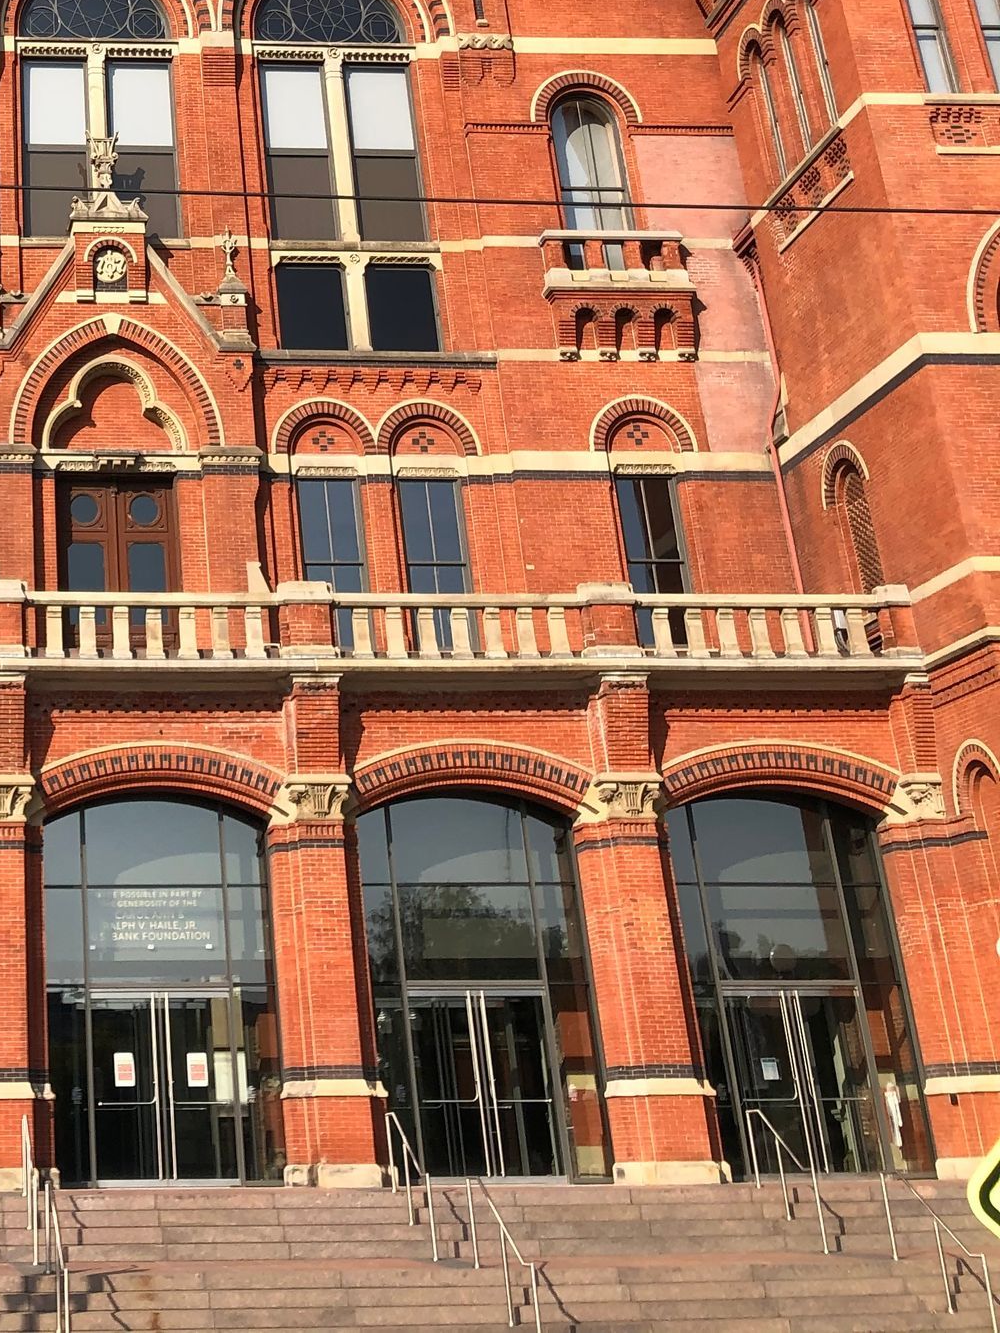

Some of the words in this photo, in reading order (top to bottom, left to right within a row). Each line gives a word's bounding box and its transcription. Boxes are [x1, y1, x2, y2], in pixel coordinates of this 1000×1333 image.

[170, 890, 190, 898] PART
[116, 899, 167, 908] GENEROSITY
[168, 899, 180, 907] OF
[182, 899, 198, 907] THE
[111, 931, 141, 941] BANK
[141, 931, 211, 941] FOUNDATION
